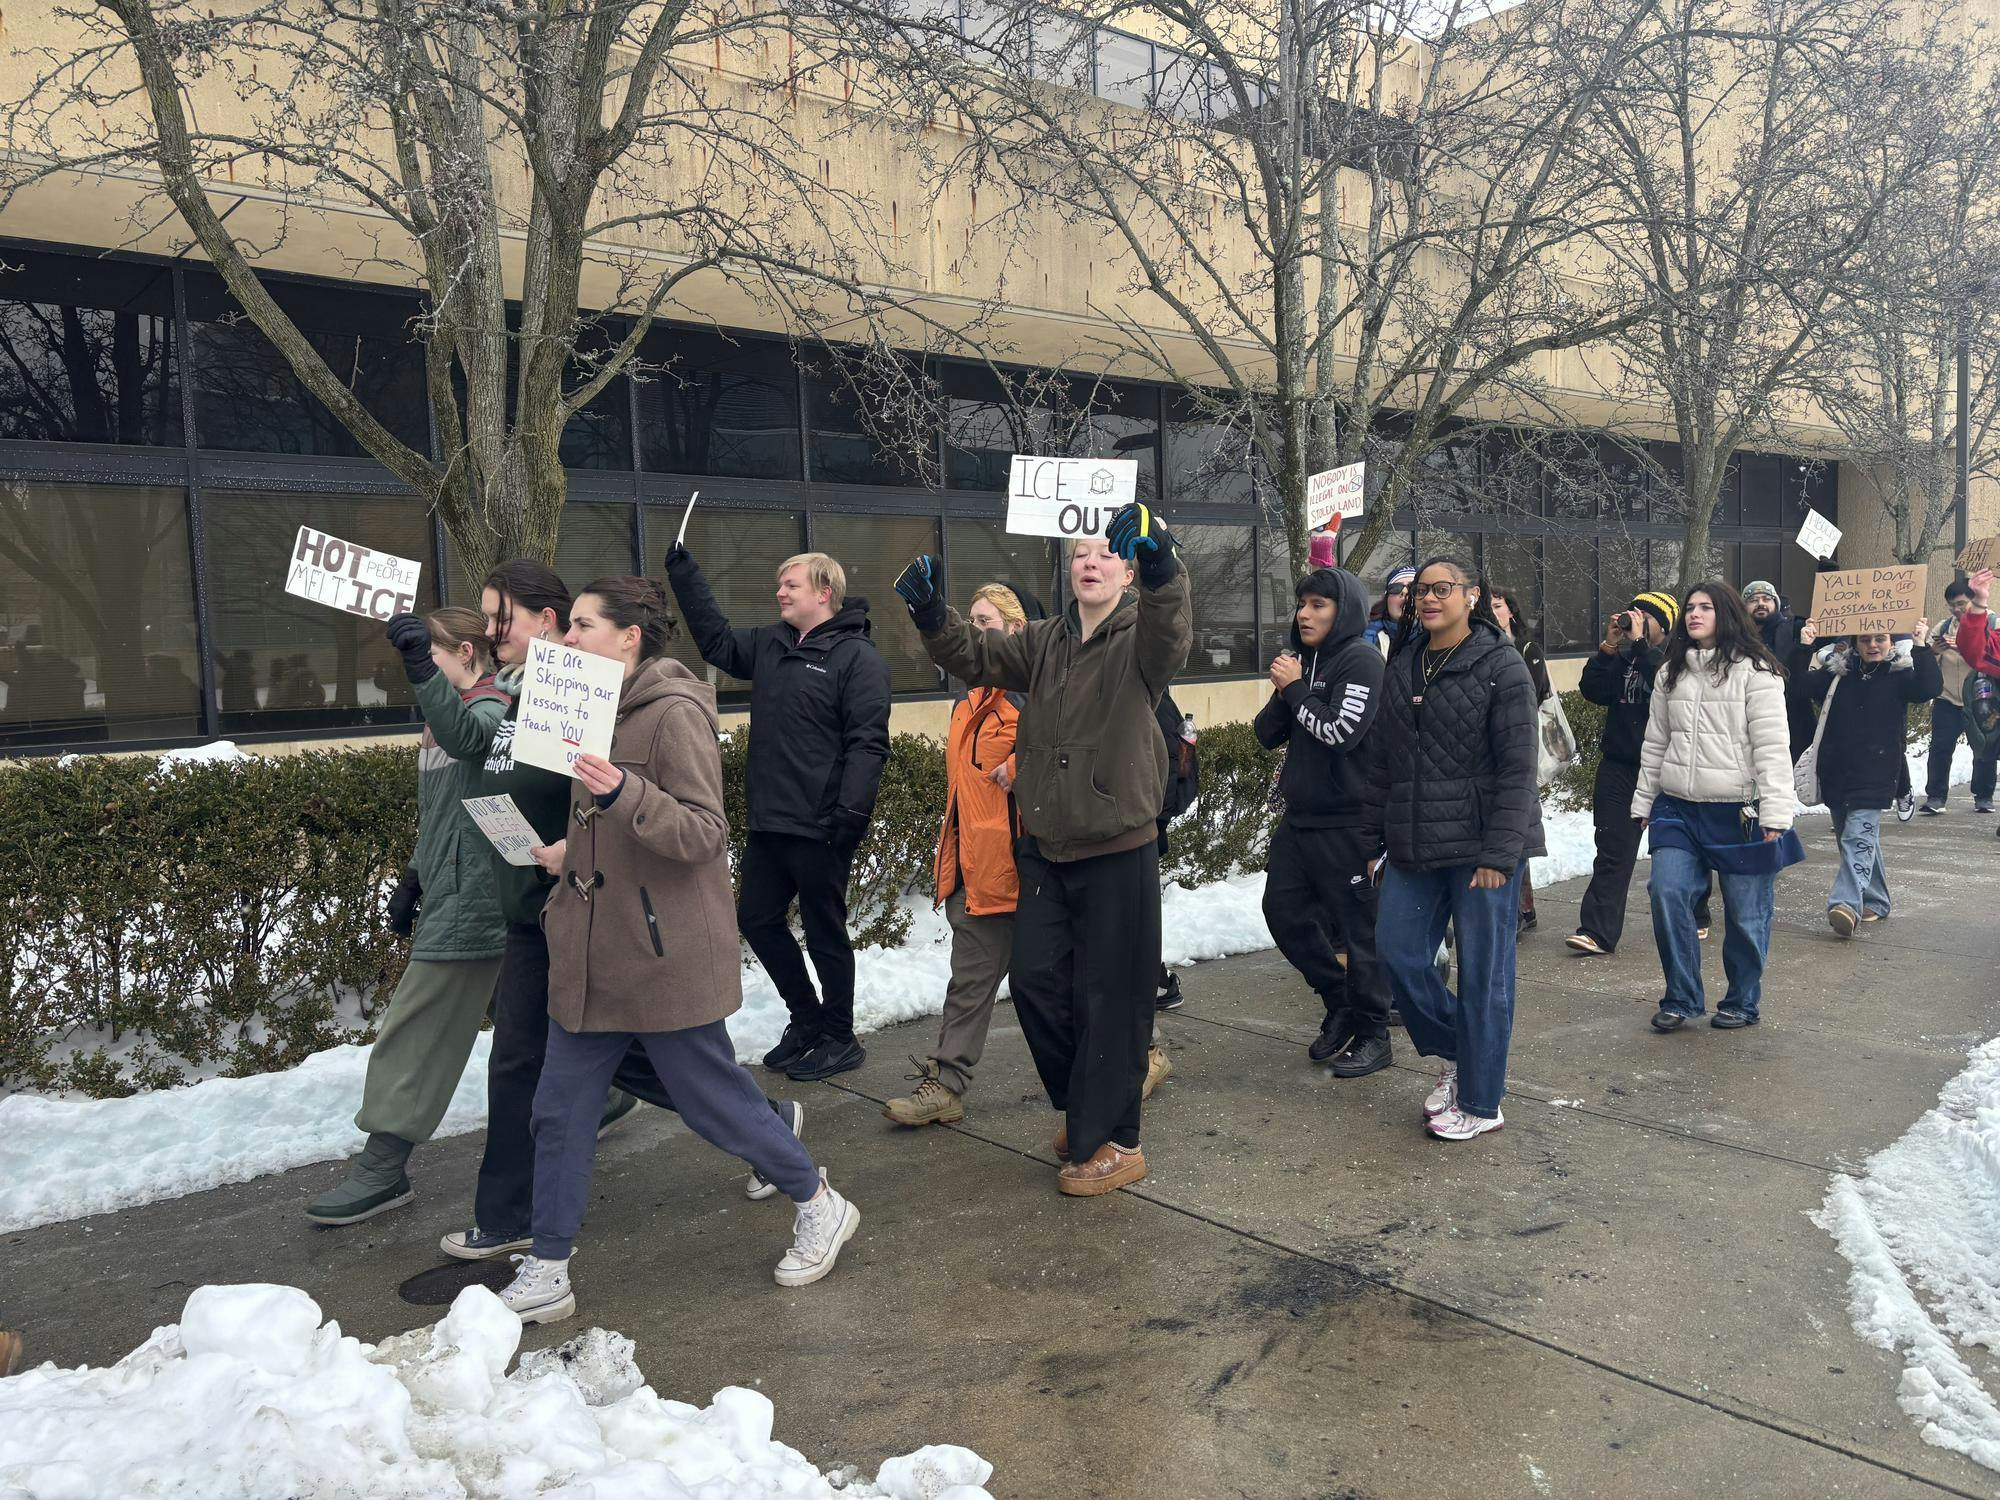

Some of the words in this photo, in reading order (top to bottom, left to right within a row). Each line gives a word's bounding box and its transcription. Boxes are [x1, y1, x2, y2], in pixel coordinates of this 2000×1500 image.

[1014, 458, 1079, 501] ICE
[1312, 467, 1347, 493] NOBODY
[1349, 465, 1358, 477] IS
[1309, 487, 1334, 506] ILLEGAL
[1337, 483, 1348, 495] ON
[1058, 503, 1121, 536] OUT
[1310, 503, 1336, 523] STOLEN
[1338, 496, 1362, 511] LAND
[295, 527, 371, 580] HOT
[366, 560, 415, 586] PEOPLE
[1872, 569, 1915, 583] DONT
[286, 563, 348, 607] MELT
[346, 579, 415, 619] ICE
[1824, 591, 1861, 602] LOOK
[1871, 588, 1893, 600] FOR
[1819, 602, 1877, 618] MISSING
[1882, 598, 1911, 609] KIDS
[1815, 618, 1847, 636] THIS
[1859, 617, 1897, 632] HARD
[534, 644, 556, 665] WE
[536, 666, 590, 702] Skipping
[594, 686, 615, 701] our
[527, 690, 569, 715] lessons
[574, 703, 589, 721] to
[522, 712, 552, 734] teach
[560, 720, 584, 742] YOU
[464, 800, 488, 819] NO
[481, 797, 507, 814] ONE
[500, 795, 517, 814] IS
[478, 815, 532, 836] ILLEGAL
[493, 840, 510, 855] ON
